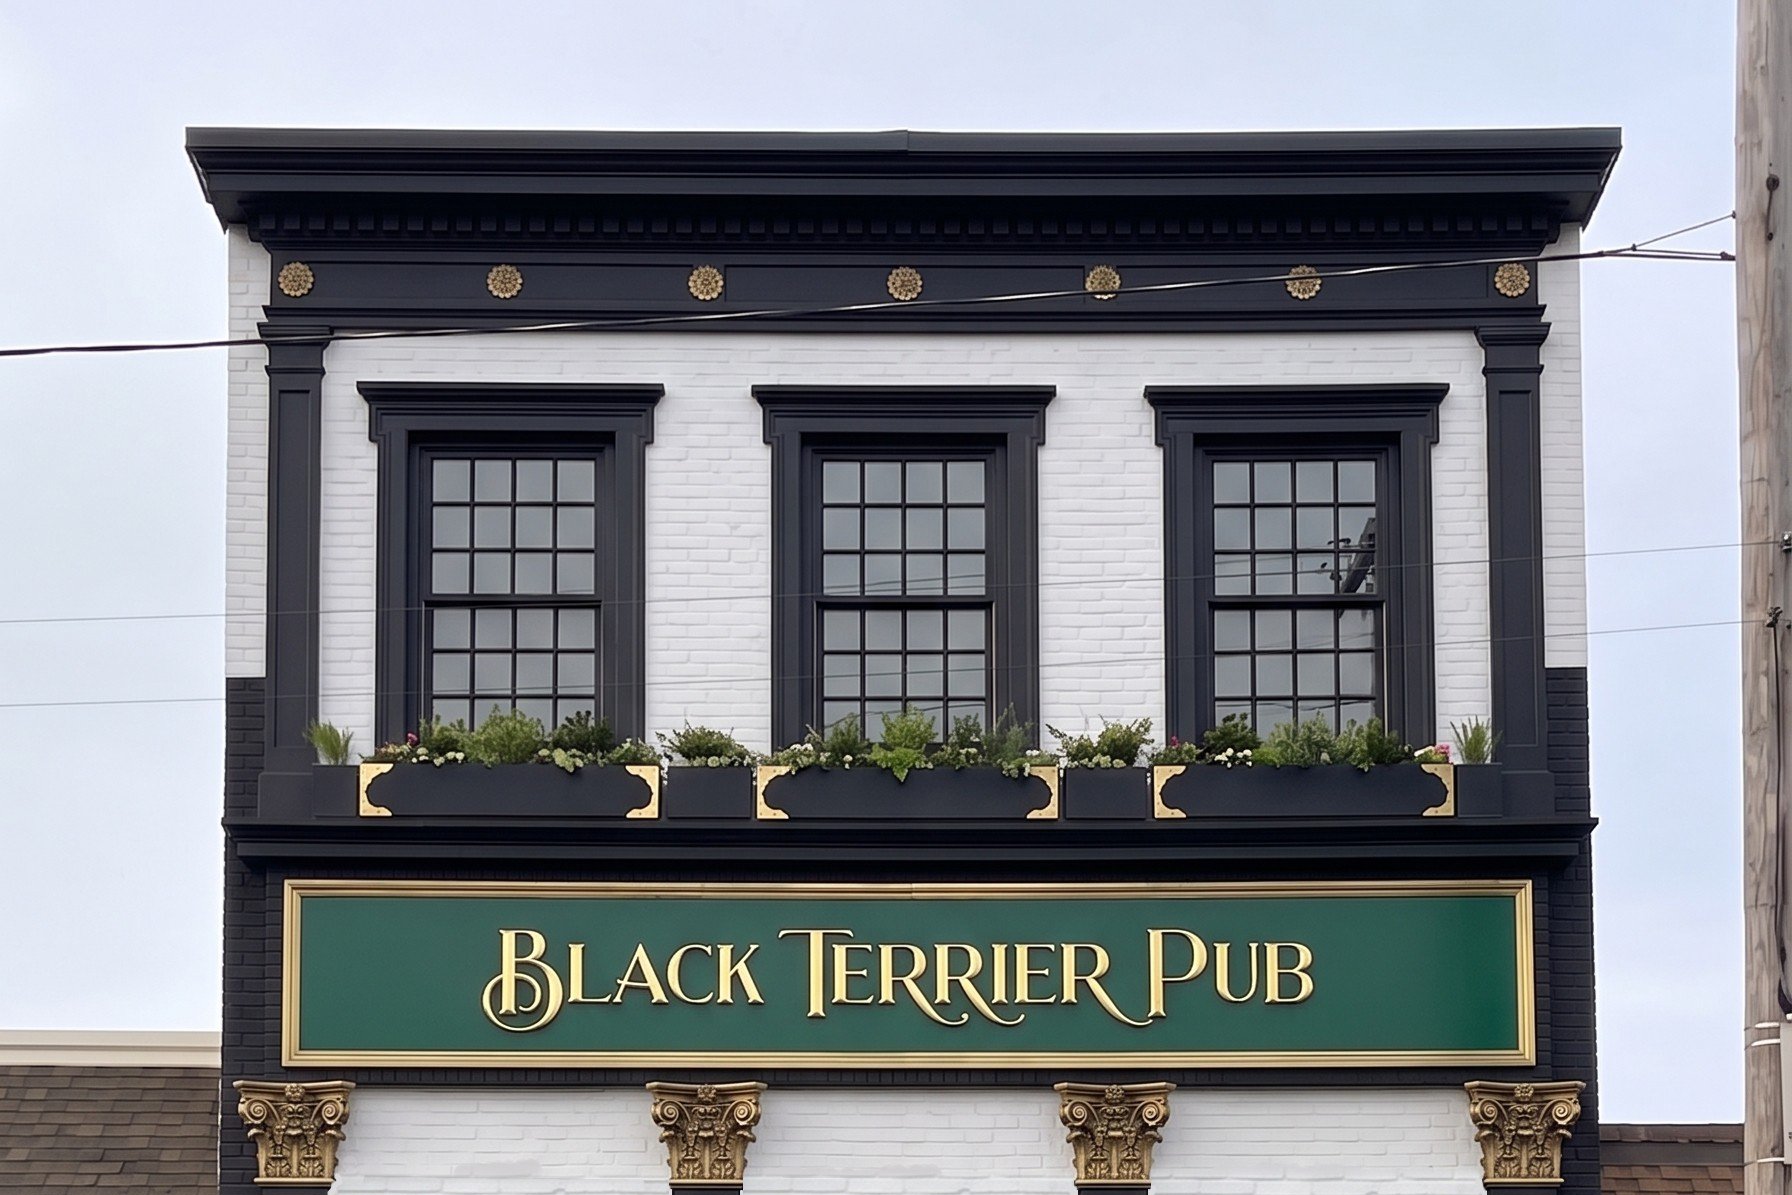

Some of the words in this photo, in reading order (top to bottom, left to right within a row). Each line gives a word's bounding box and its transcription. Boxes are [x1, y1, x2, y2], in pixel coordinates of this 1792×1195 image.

[482, 928, 764, 1032] BLACK
[778, 927, 1153, 1027] TERRIER
[1147, 927, 1314, 1020] PUB
